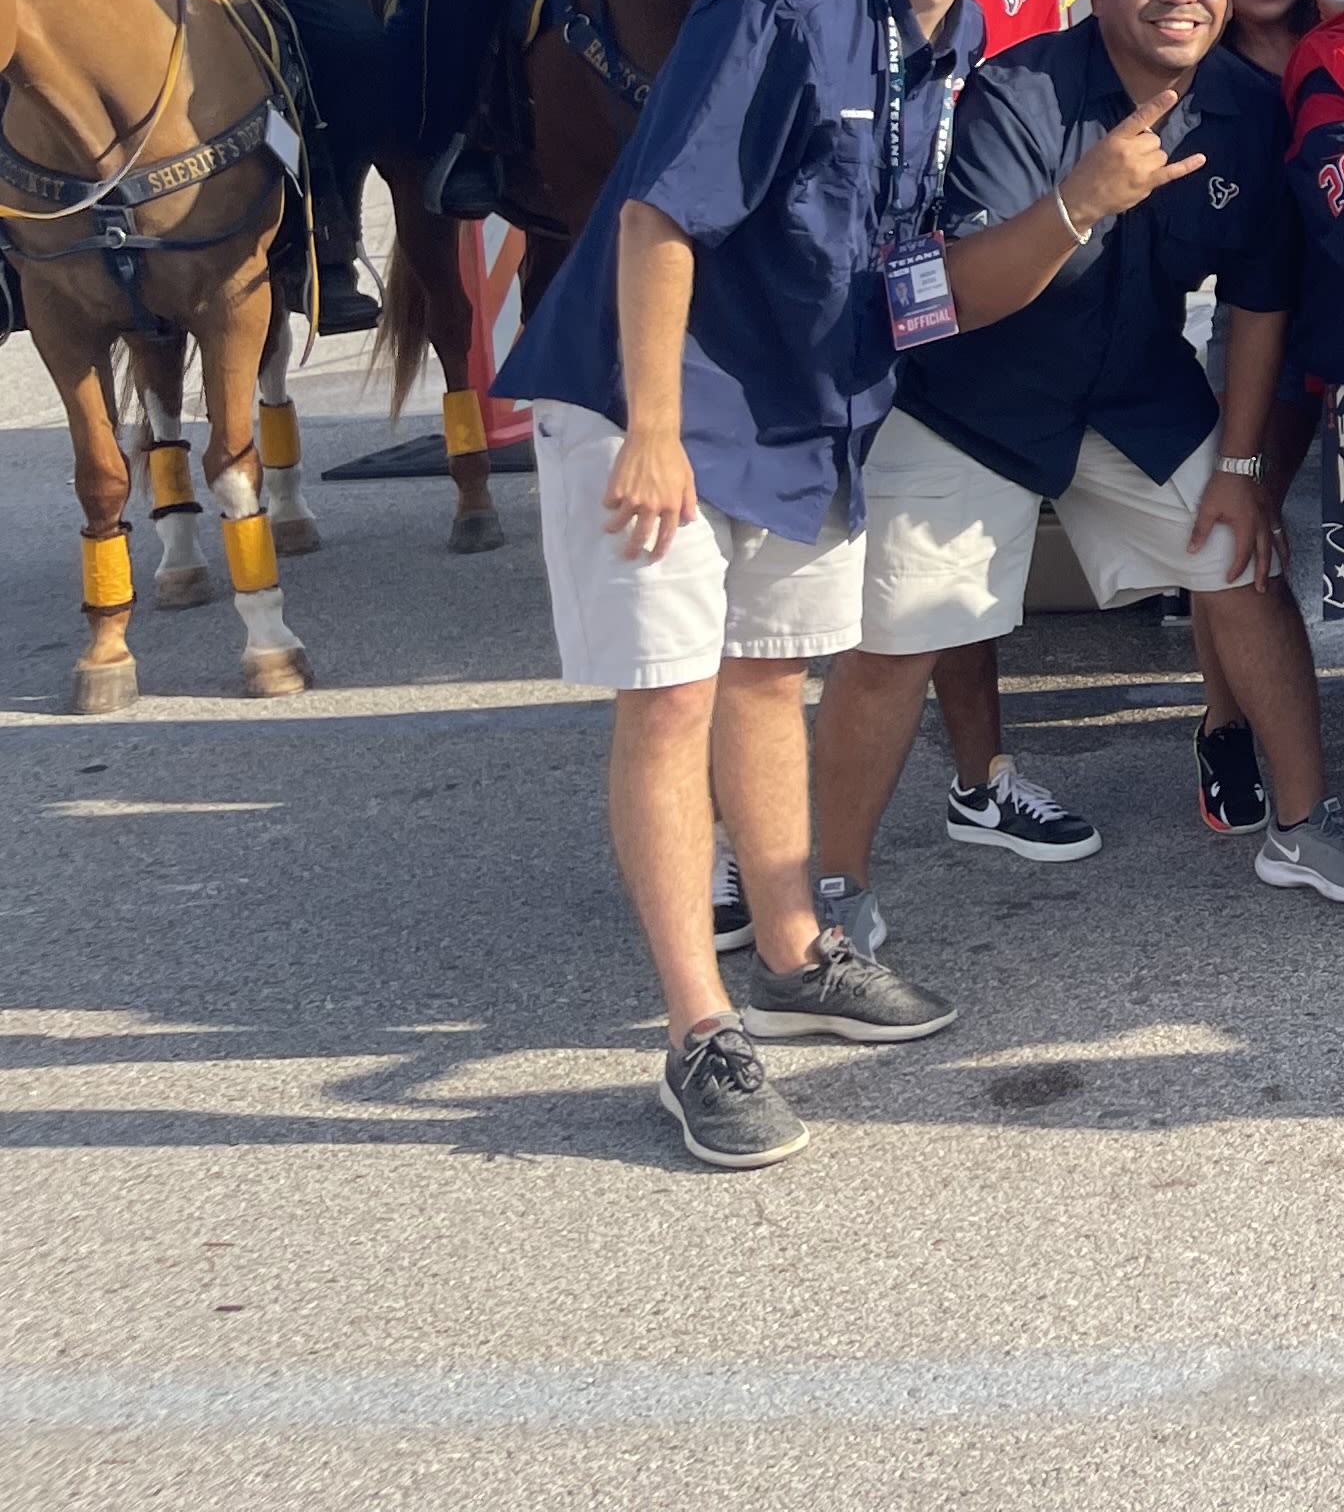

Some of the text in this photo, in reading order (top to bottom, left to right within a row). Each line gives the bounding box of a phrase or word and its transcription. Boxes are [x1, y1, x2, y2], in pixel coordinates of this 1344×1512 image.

[889, 97, 901, 168] TEXANS
[147, 139, 242, 194] SHERIFF'S
[887, 248, 940, 269] TEXANS
[906, 309, 951, 332] OFFICIAL
